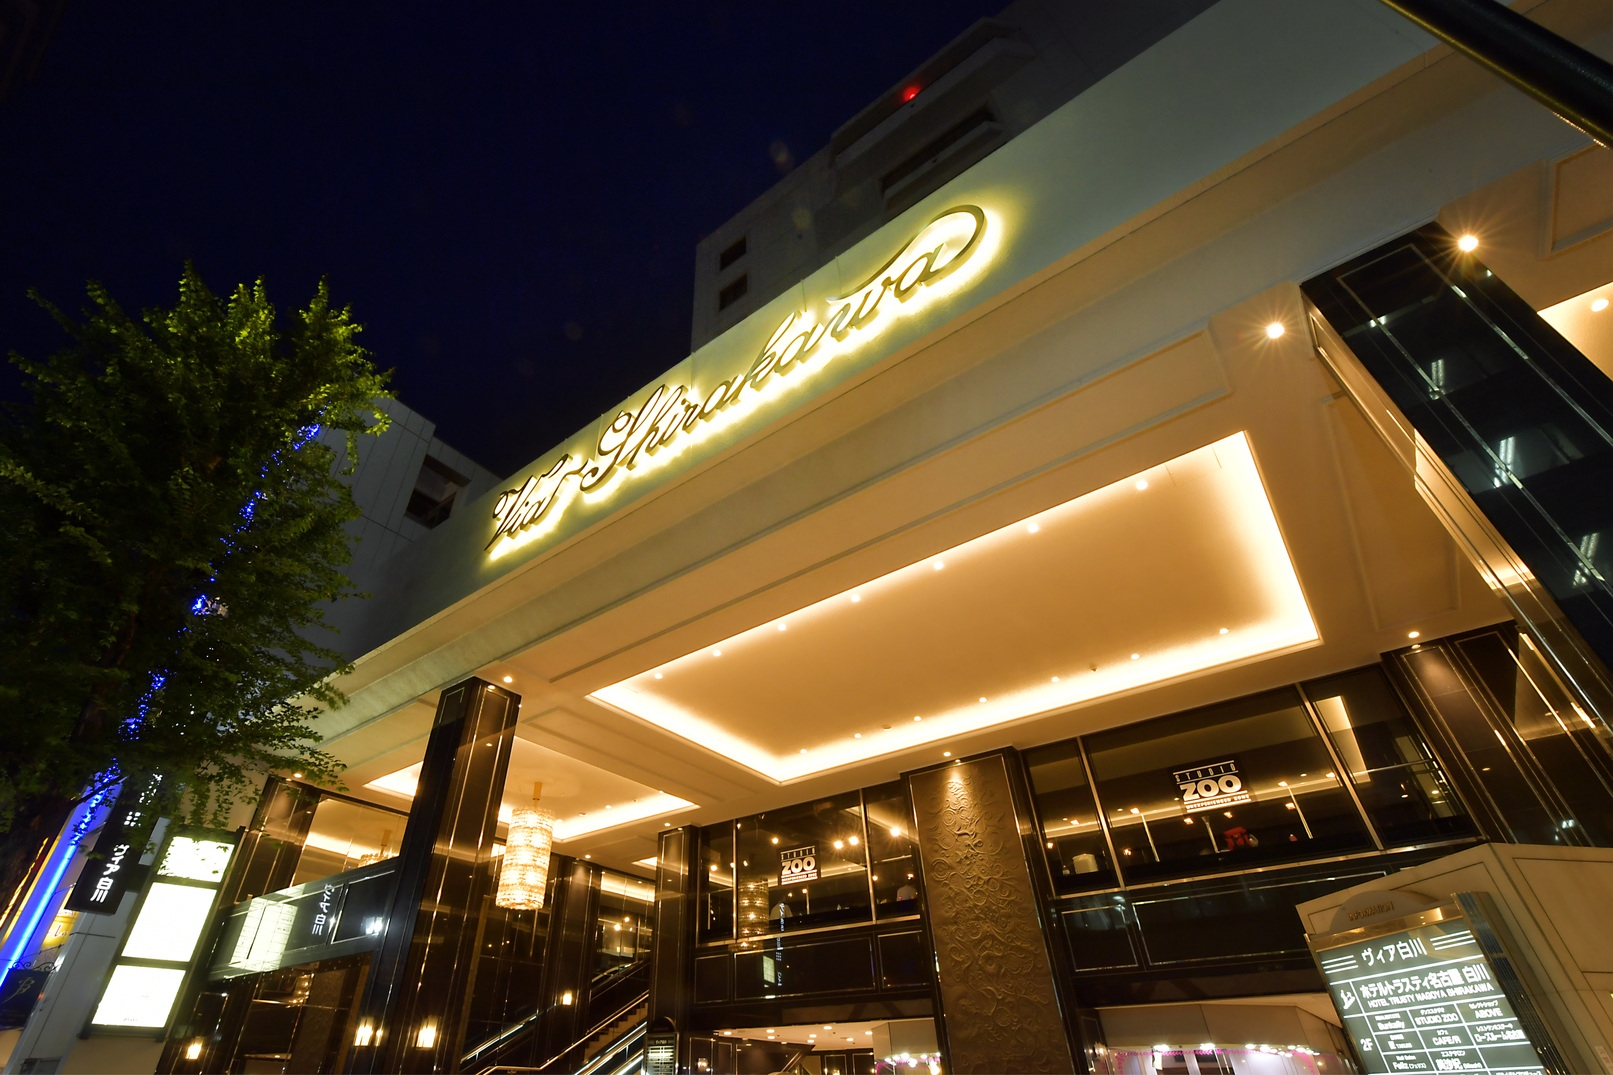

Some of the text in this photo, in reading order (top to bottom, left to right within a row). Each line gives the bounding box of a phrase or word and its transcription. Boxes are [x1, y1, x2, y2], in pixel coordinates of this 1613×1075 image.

[484, 204, 984, 551] Via Shirakawa
[1175, 763, 1236, 782] STUDIO
[1179, 774, 1242, 801] ZOO
[90, 844, 129, 903] ヴィア白川
[781, 856, 816, 875] ZOO
[1348, 901, 1395, 921] INFORMATION
[1361, 937, 1428, 967] ヴィア白川
[1360, 963, 1491, 999] ホテルトラスティ名古屋 白川
[1367, 982, 1495, 1008] HOTEL TRUSTY NAGOYA SHIRAKAWA
[1414, 1014, 1442, 1026] STUDIO
[1440, 1012, 1459, 1022] ZOO
[1474, 1007, 1503, 1019] ABOVE
[1360, 1038, 1373, 1051] 2F
